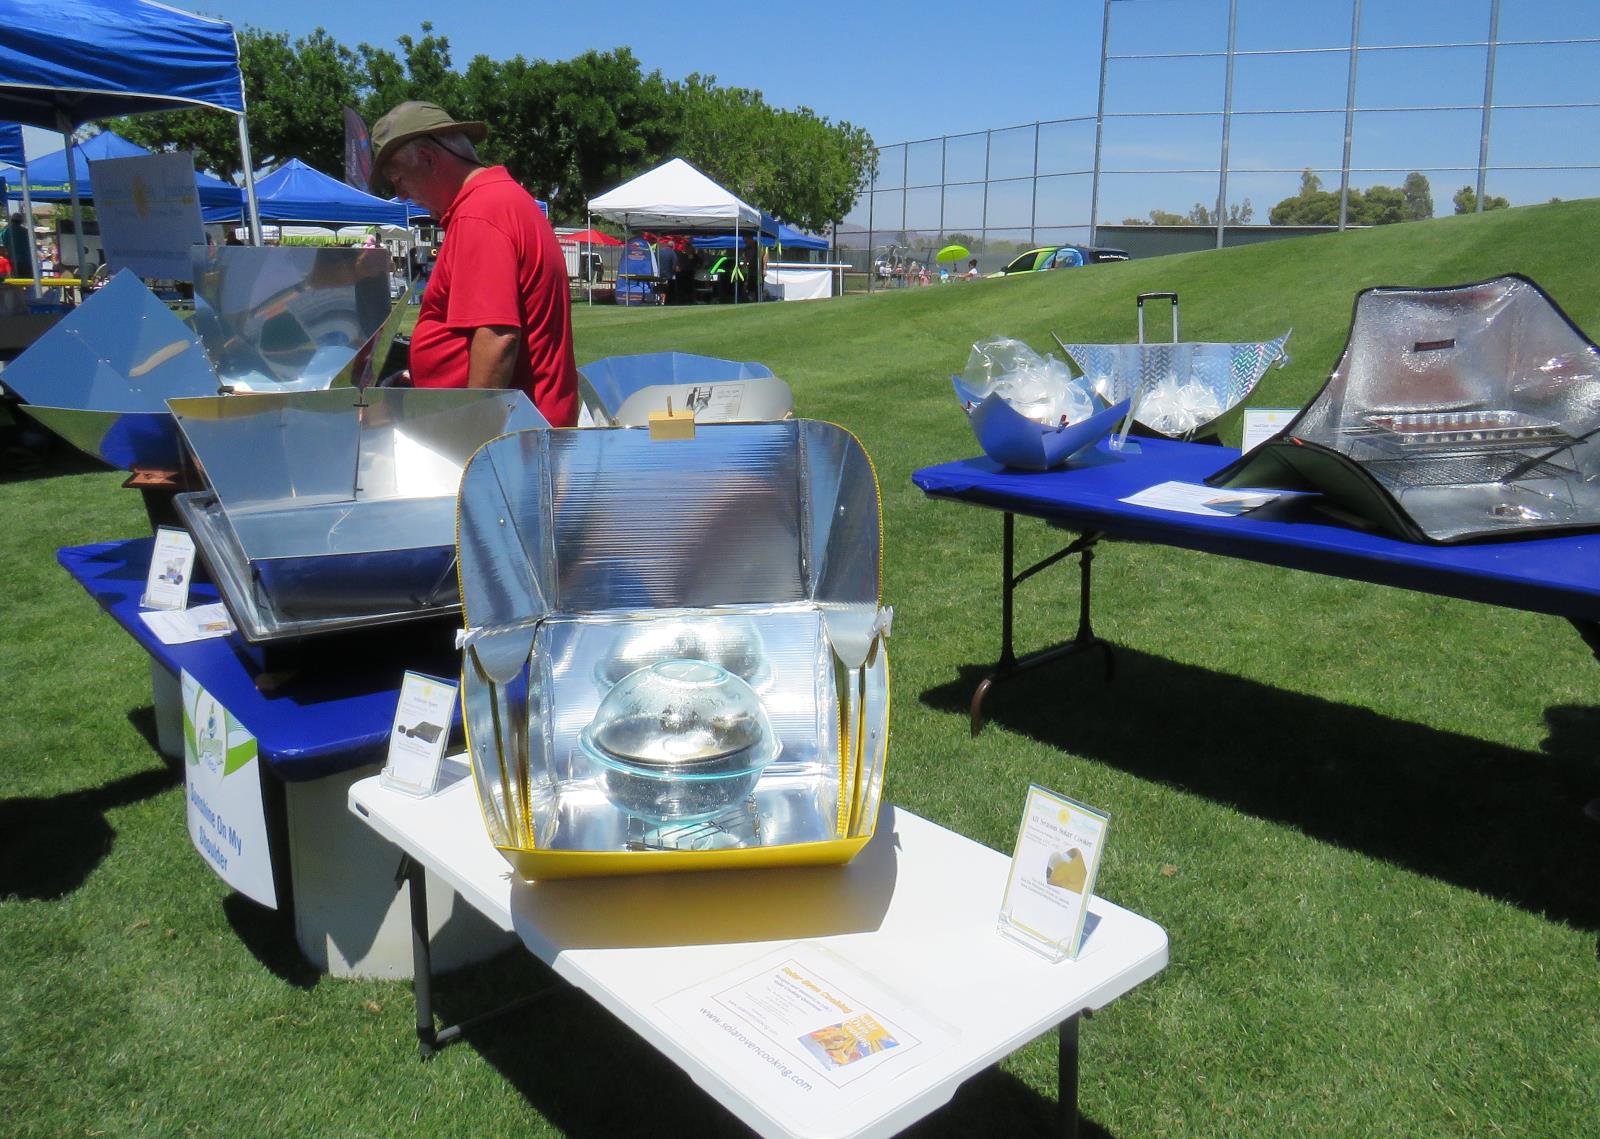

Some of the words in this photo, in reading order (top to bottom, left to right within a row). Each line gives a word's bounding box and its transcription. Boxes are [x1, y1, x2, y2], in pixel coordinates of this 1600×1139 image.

[190, 782, 216, 828] Sunshine
[217, 814, 227, 840] On
[228, 826, 242, 856] My
[199, 825, 228, 872] Shoulder
[699, 1007, 813, 1092] www.solarovencooking.com
